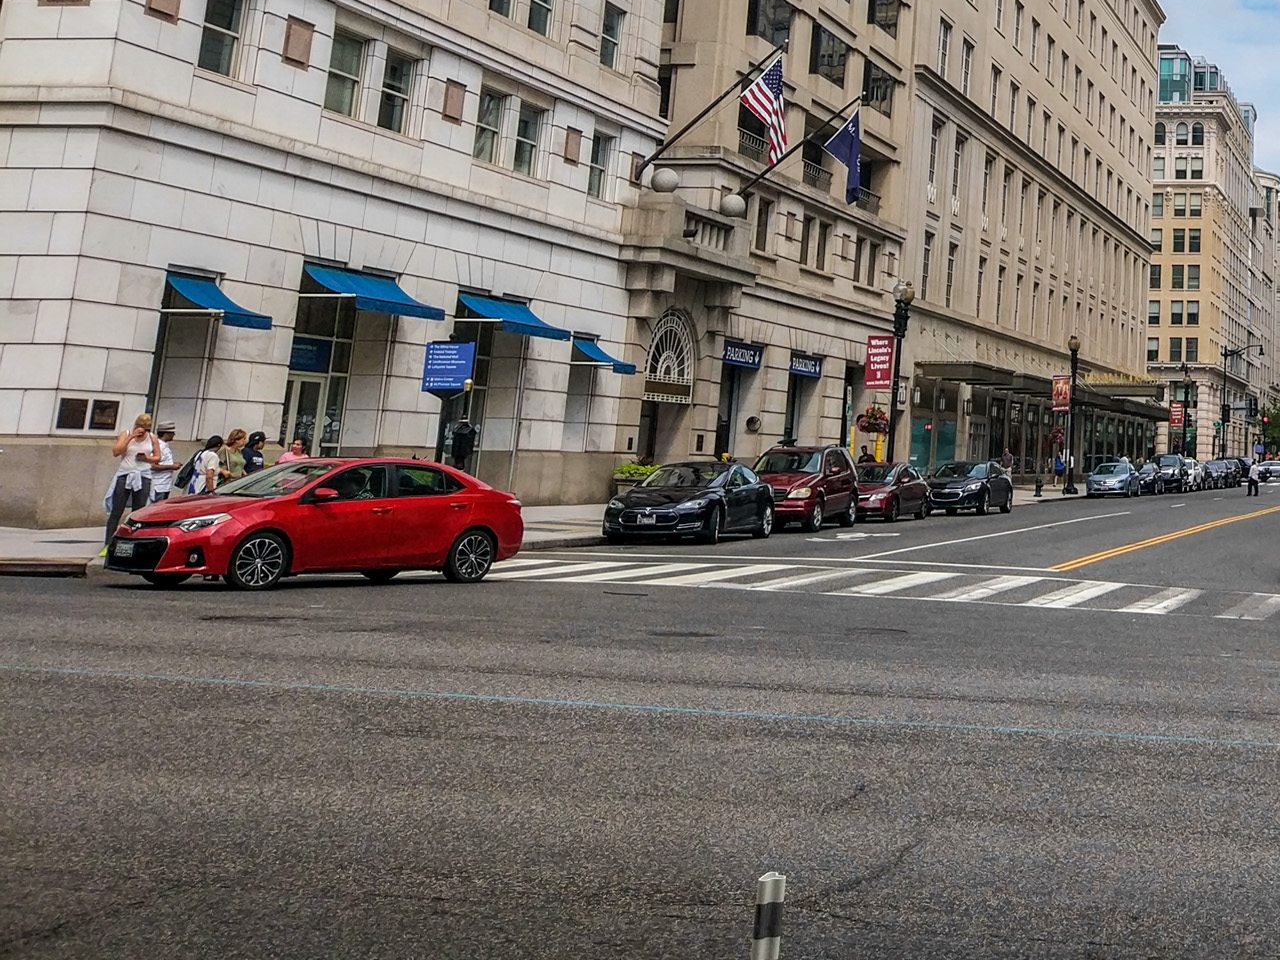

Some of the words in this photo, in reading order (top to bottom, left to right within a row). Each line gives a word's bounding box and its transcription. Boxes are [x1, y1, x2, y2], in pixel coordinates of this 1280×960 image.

[726, 346, 754, 363] PARKING
[868, 346, 891, 354] Lincoln's
[792, 357, 815, 372] PARKING
